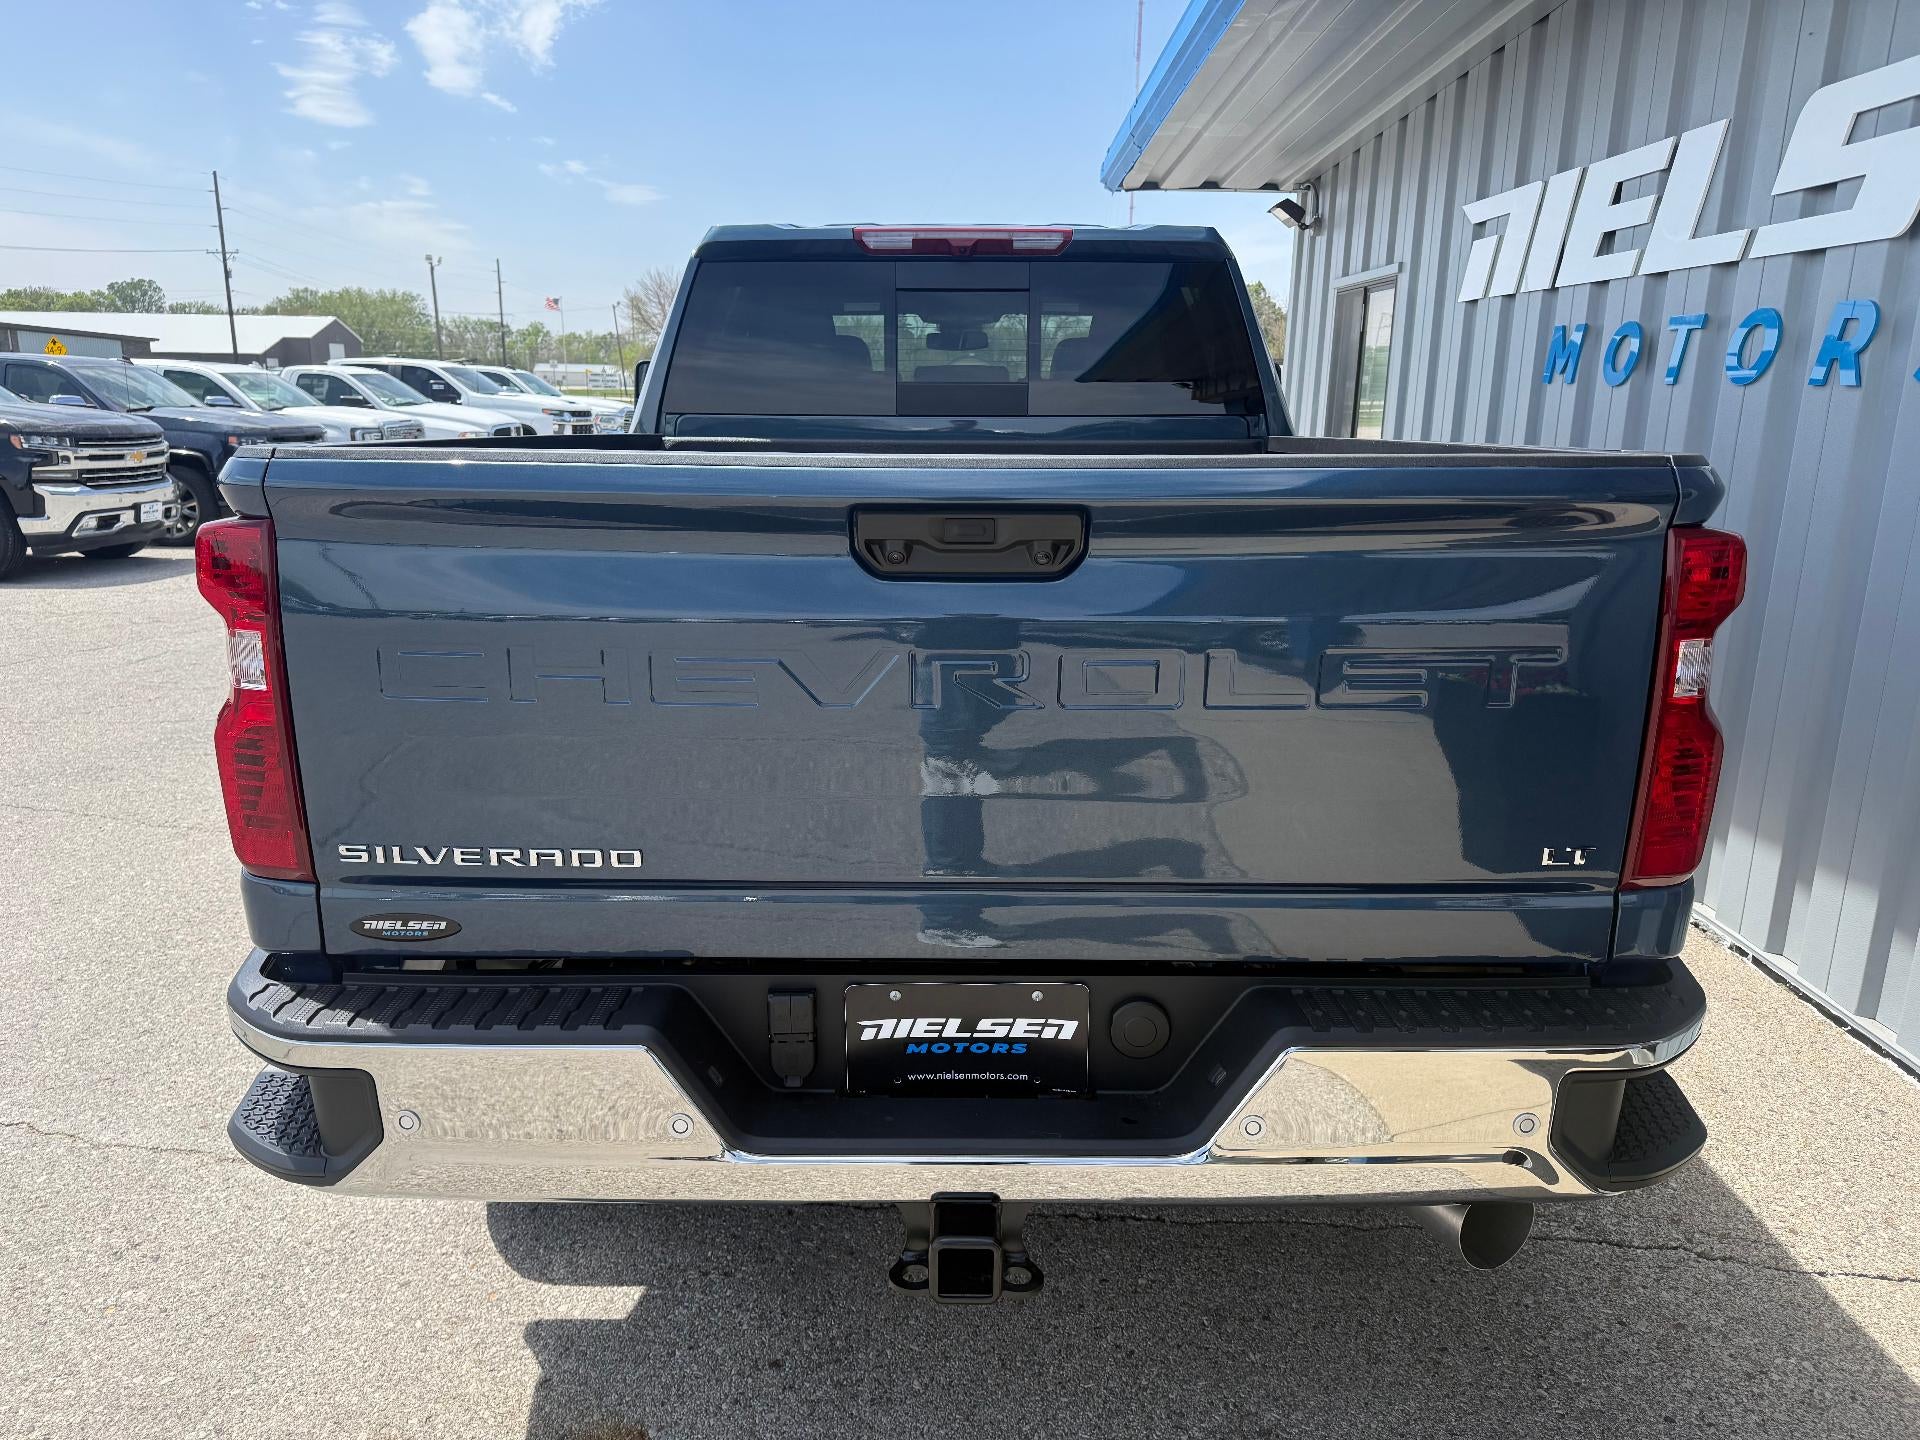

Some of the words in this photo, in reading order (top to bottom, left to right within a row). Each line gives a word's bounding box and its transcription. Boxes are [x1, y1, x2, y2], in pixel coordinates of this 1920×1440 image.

[1543, 300, 1920, 387] MOTOR
[376, 642, 1568, 709] CHEVROLET
[338, 844, 643, 868] SILVERADO
[1541, 847, 1597, 866] LT
[361, 920, 448, 930] NIELSEN
[857, 1017, 1079, 1041] NIELSEN
[906, 1042, 1028, 1055] MOTORS
[907, 1069, 1029, 1082] www.nielsenmotors.com
